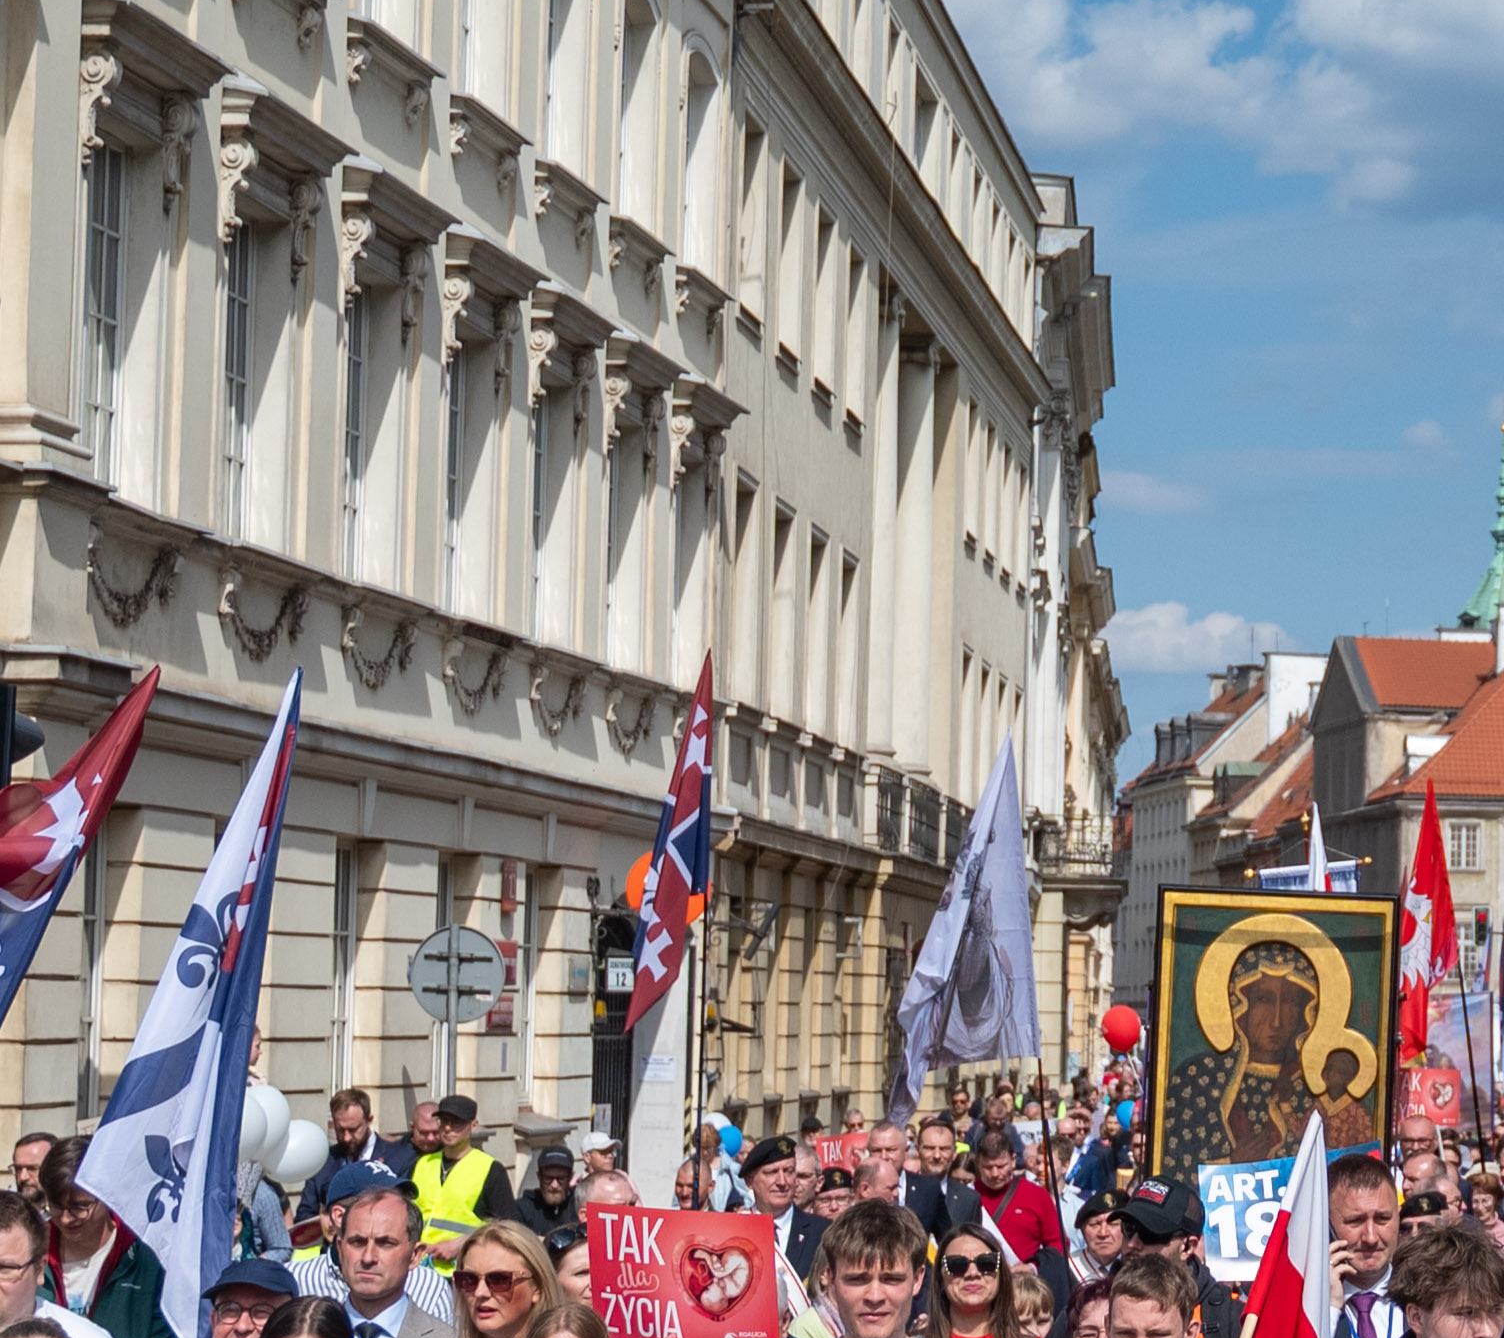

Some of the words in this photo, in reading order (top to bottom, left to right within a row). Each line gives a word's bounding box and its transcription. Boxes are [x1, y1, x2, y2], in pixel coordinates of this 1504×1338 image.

[616, 972, 627, 987] 12
[821, 1139, 844, 1164] TAK
[1207, 1169, 1287, 1203] ART.
[598, 1212, 666, 1266] TAK
[1208, 1201, 1281, 1258] 18
[617, 1261, 660, 1297] dla
